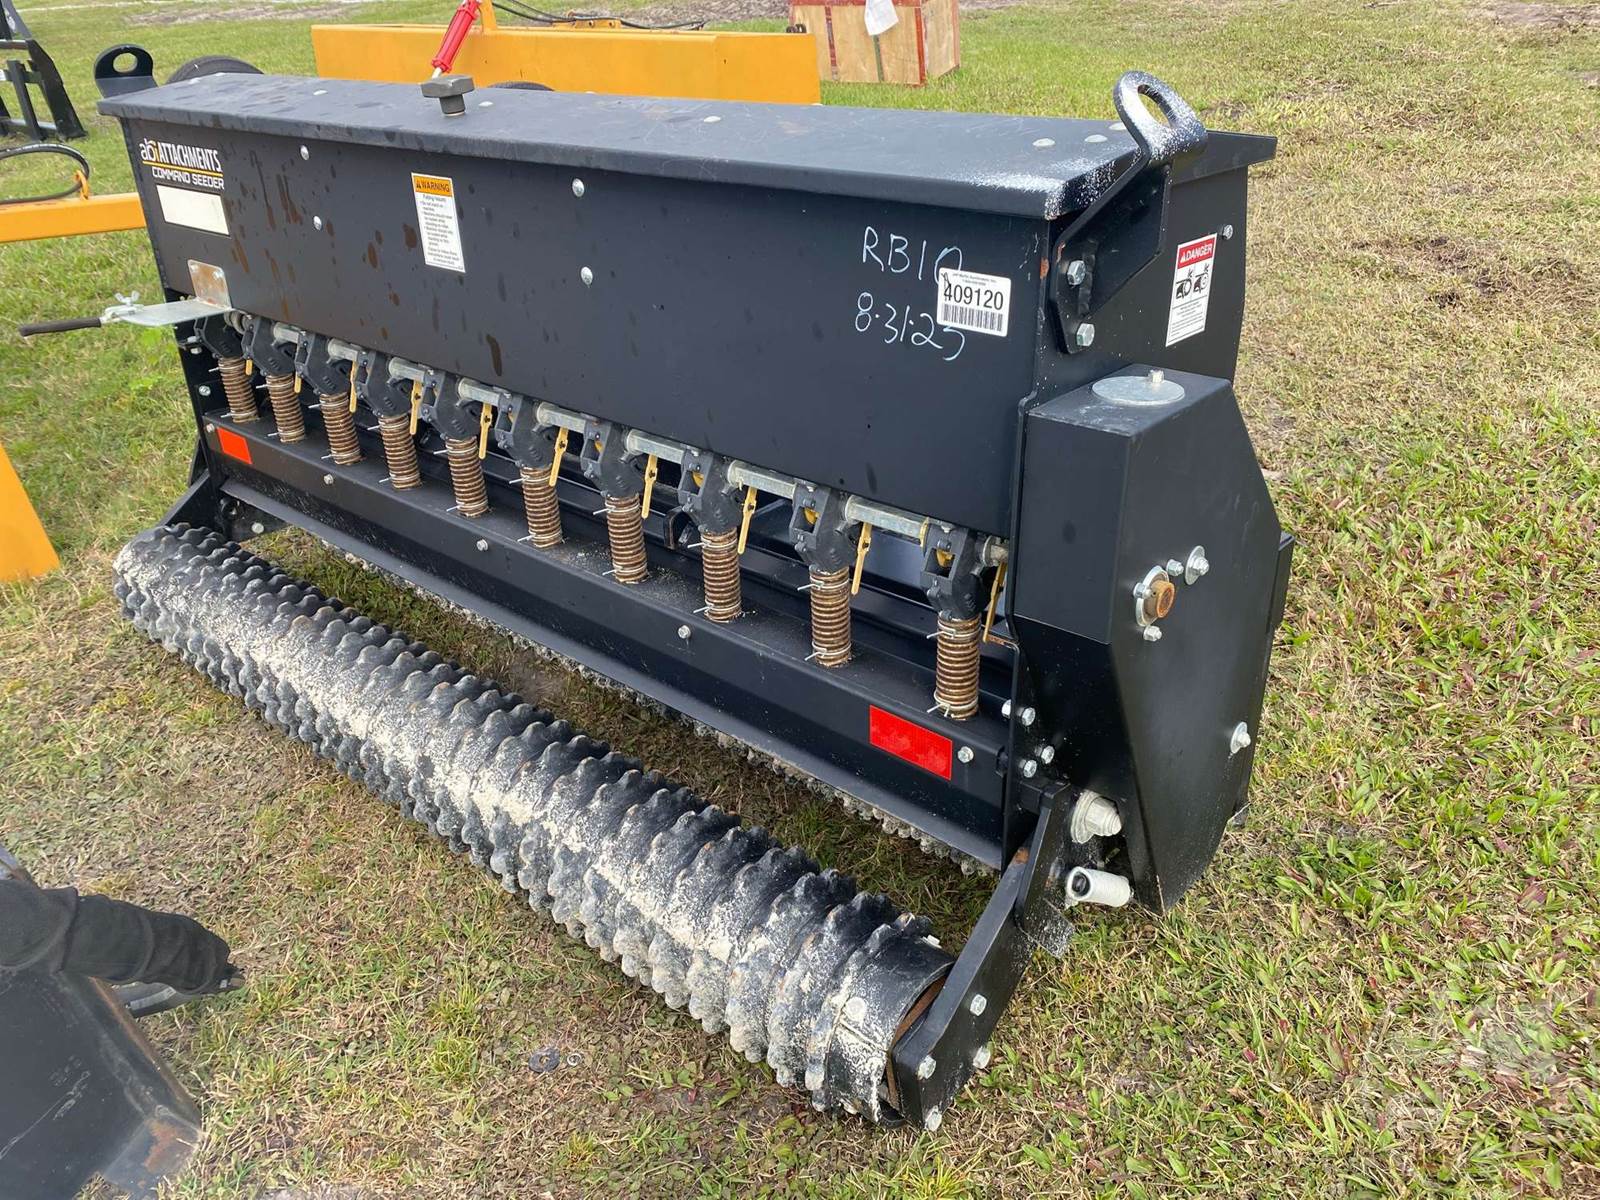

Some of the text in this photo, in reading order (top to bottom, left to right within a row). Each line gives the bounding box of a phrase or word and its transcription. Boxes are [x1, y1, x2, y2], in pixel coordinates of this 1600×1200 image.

[157, 142, 223, 172] ATTACHMENTS
[152, 166, 224, 190] COMMAND SEEDER
[421, 180, 450, 193] WARNING
[1184, 242, 1213, 262] DANGER
[943, 284, 1004, 311] 409120
